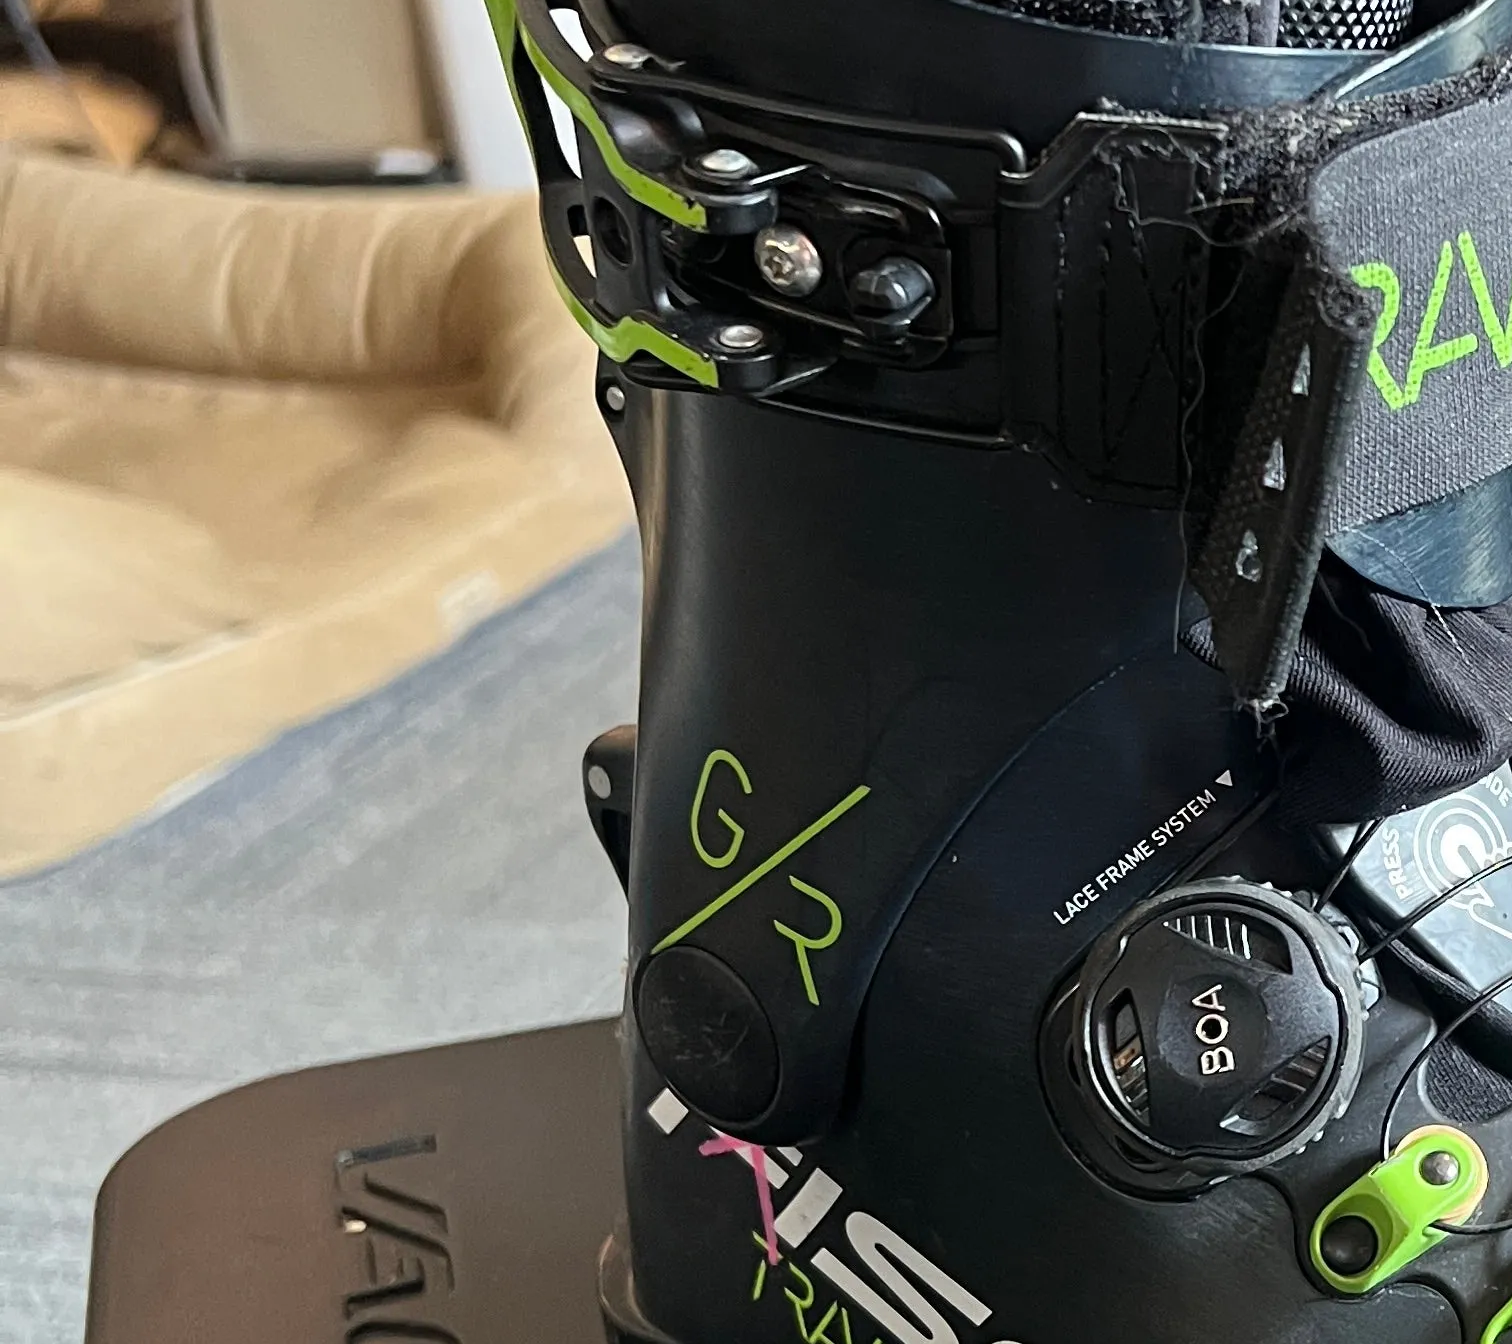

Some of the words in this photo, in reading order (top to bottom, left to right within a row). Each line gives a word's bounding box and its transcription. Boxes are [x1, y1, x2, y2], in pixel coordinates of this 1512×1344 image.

[1053, 883, 1100, 925] LACE
[1095, 839, 1155, 891] FRAME
[1151, 788, 1217, 847] SYSTEM
[1382, 827, 1412, 900] PRESS
[1192, 983, 1235, 1076] BOA
